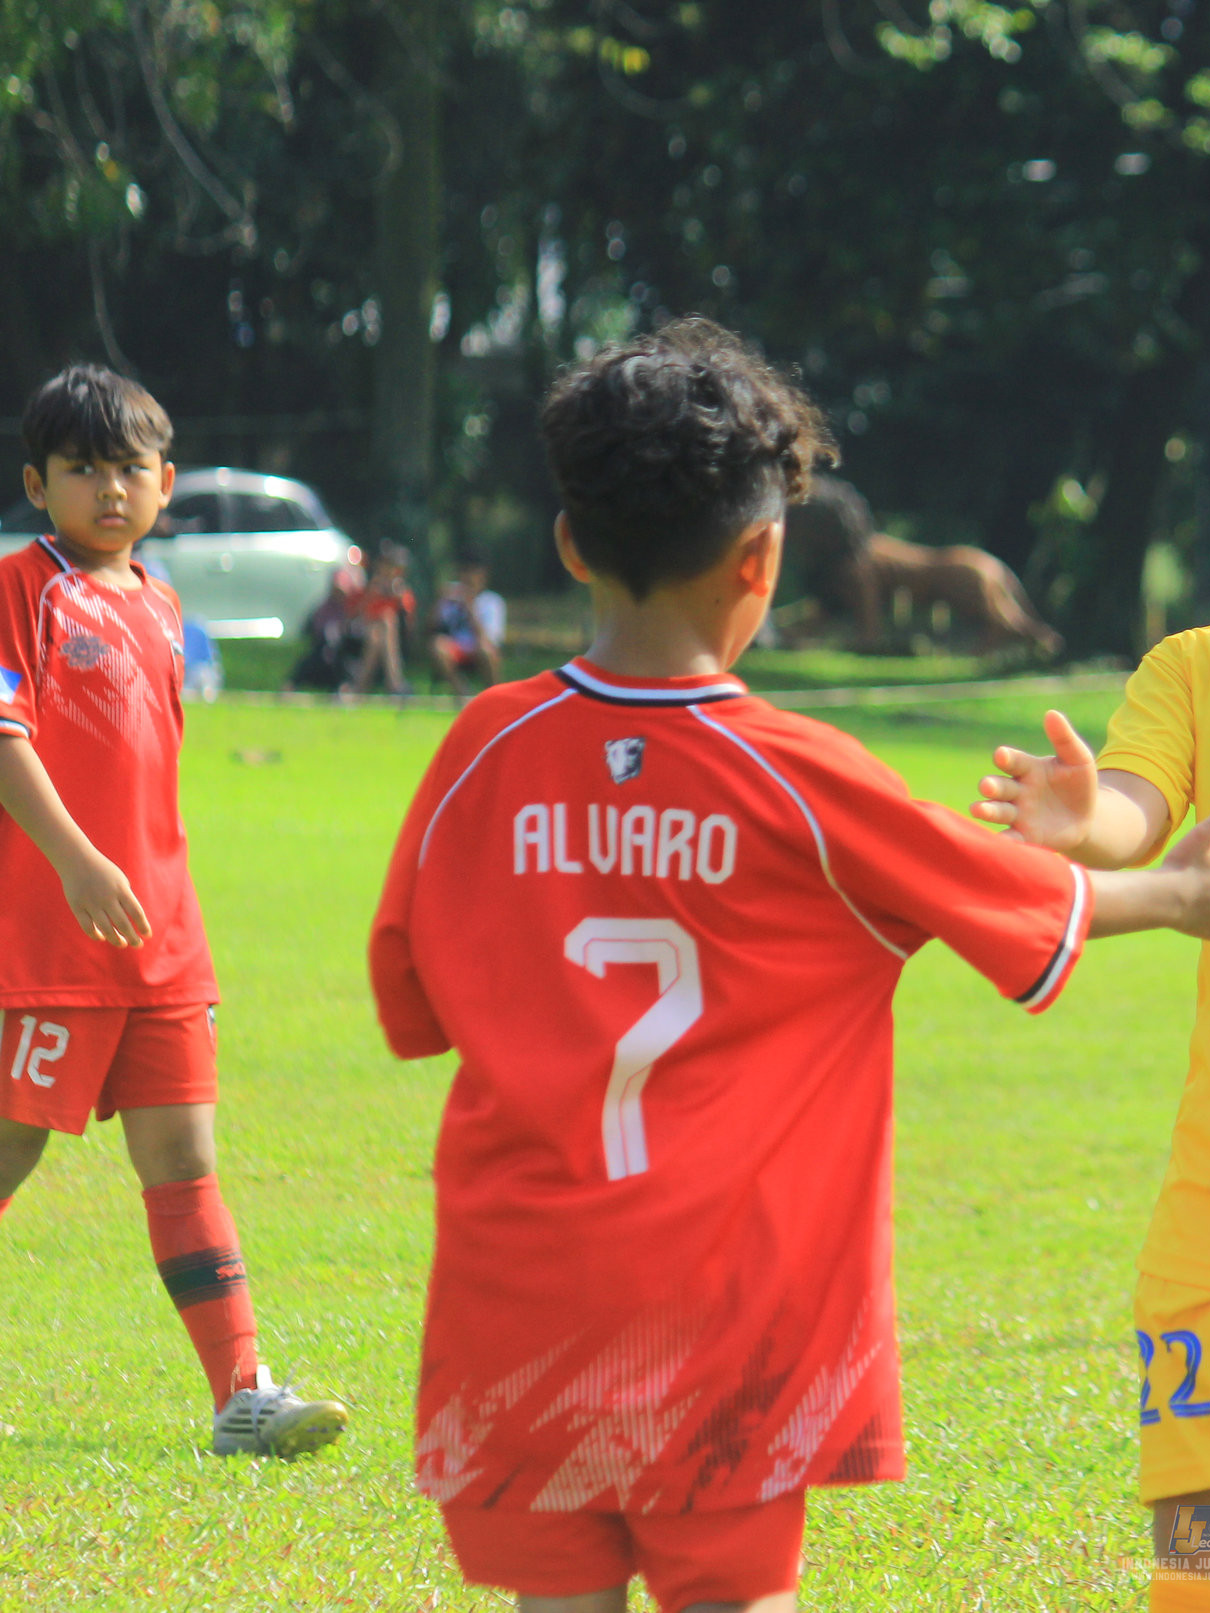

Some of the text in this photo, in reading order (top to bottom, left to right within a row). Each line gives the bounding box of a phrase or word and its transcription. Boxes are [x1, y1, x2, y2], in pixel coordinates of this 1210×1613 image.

[513, 803, 738, 884] ALVARO
[10, 1014, 70, 1089] 12
[563, 917, 704, 1182] 7
